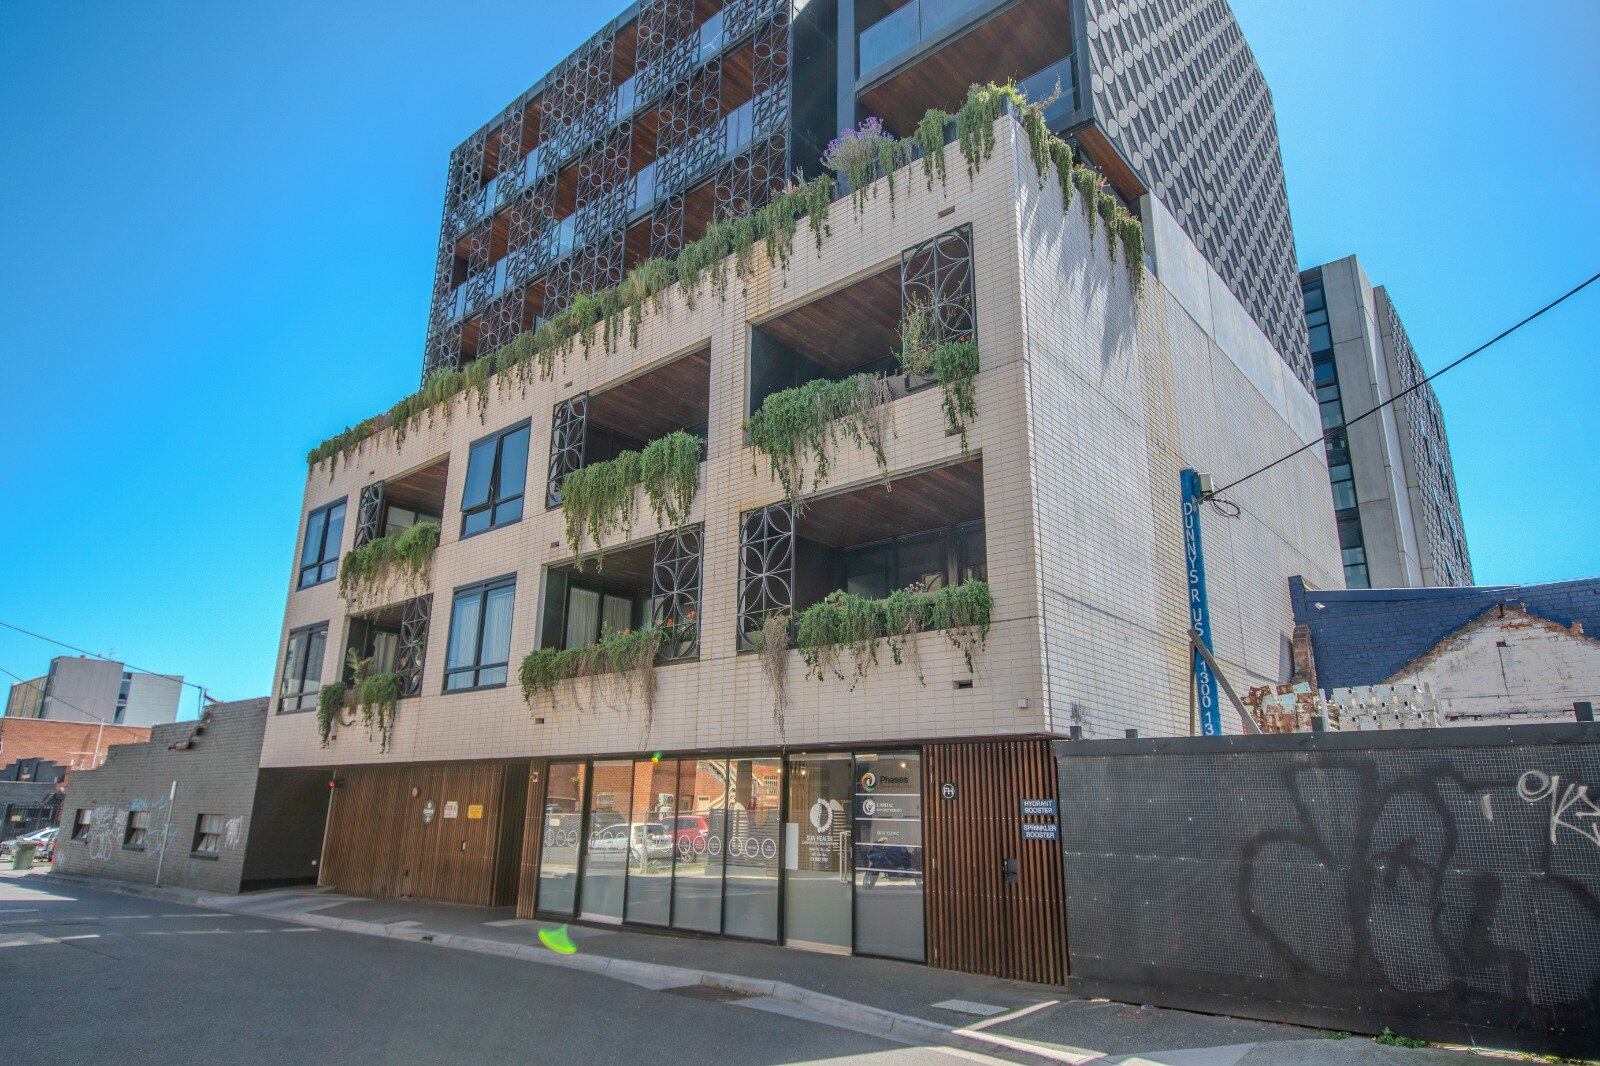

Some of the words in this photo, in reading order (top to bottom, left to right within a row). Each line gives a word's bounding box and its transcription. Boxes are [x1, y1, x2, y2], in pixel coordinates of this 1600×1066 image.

[1183, 502, 1199, 584] DUNNYS
[1191, 588, 1201, 603] R
[1192, 607, 1205, 637] US
[1200, 661, 1212, 708] 1300
[1204, 712, 1215, 736] 13
[880, 775, 909, 784] Phases
[1023, 824, 1057, 832] SPRINKLER
[1026, 831, 1055, 839] BOOSTER
